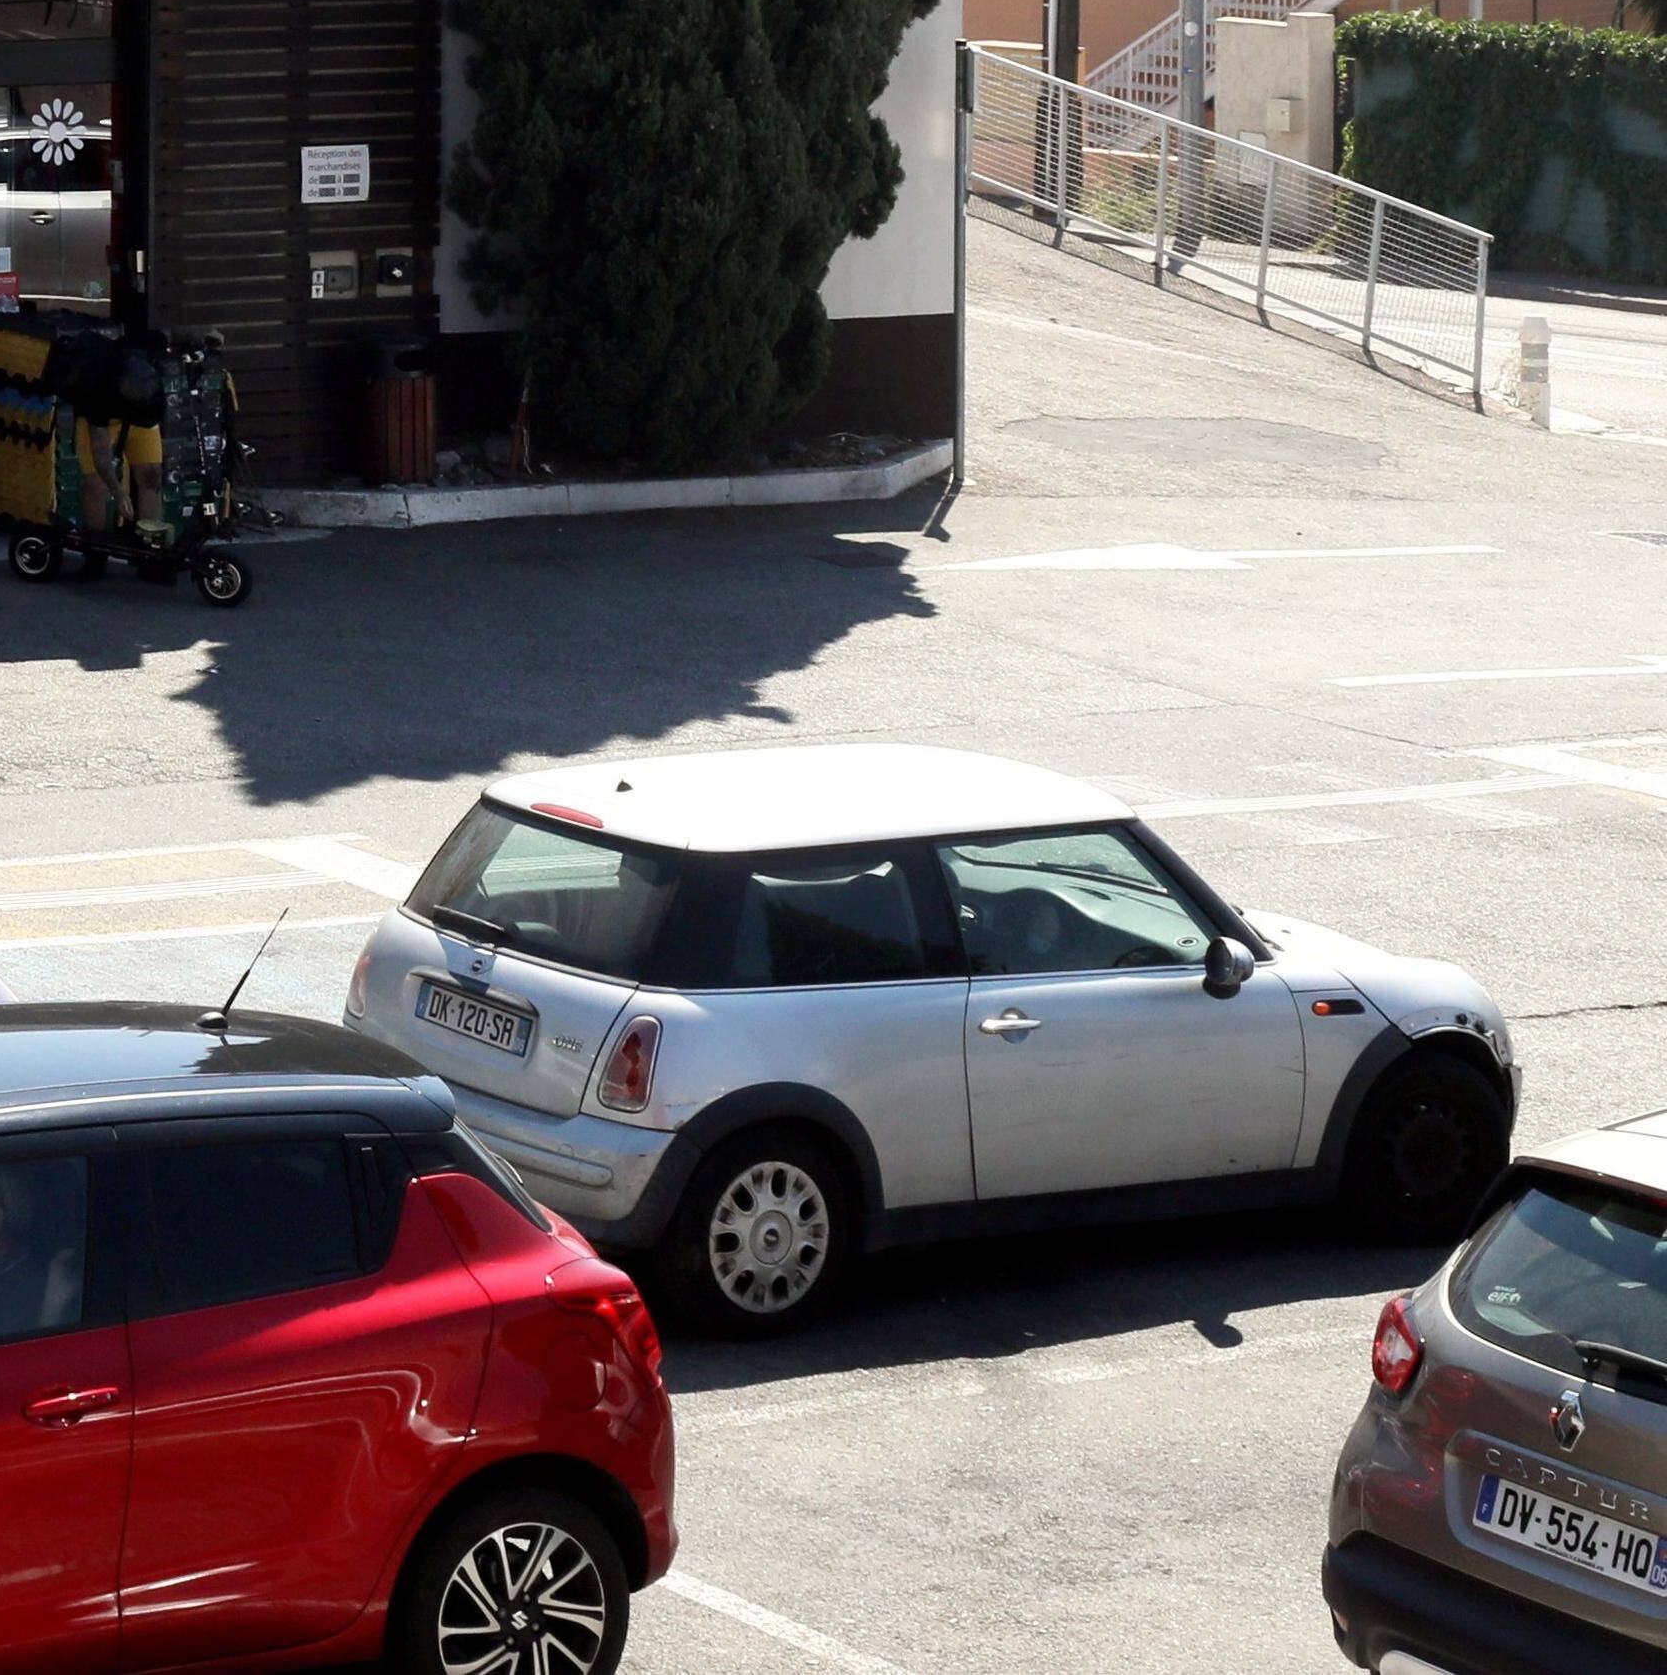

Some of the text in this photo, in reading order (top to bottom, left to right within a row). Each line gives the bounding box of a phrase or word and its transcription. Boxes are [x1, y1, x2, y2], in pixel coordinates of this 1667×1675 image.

[308, 148, 362, 160] Réception des
[308, 162, 361, 172] marchandises
[427, 990, 515, 1046] DK-120-SR
[1485, 1448, 1650, 1520] CAPTUR
[1498, 1488, 1653, 1579] DV-554-HQ
